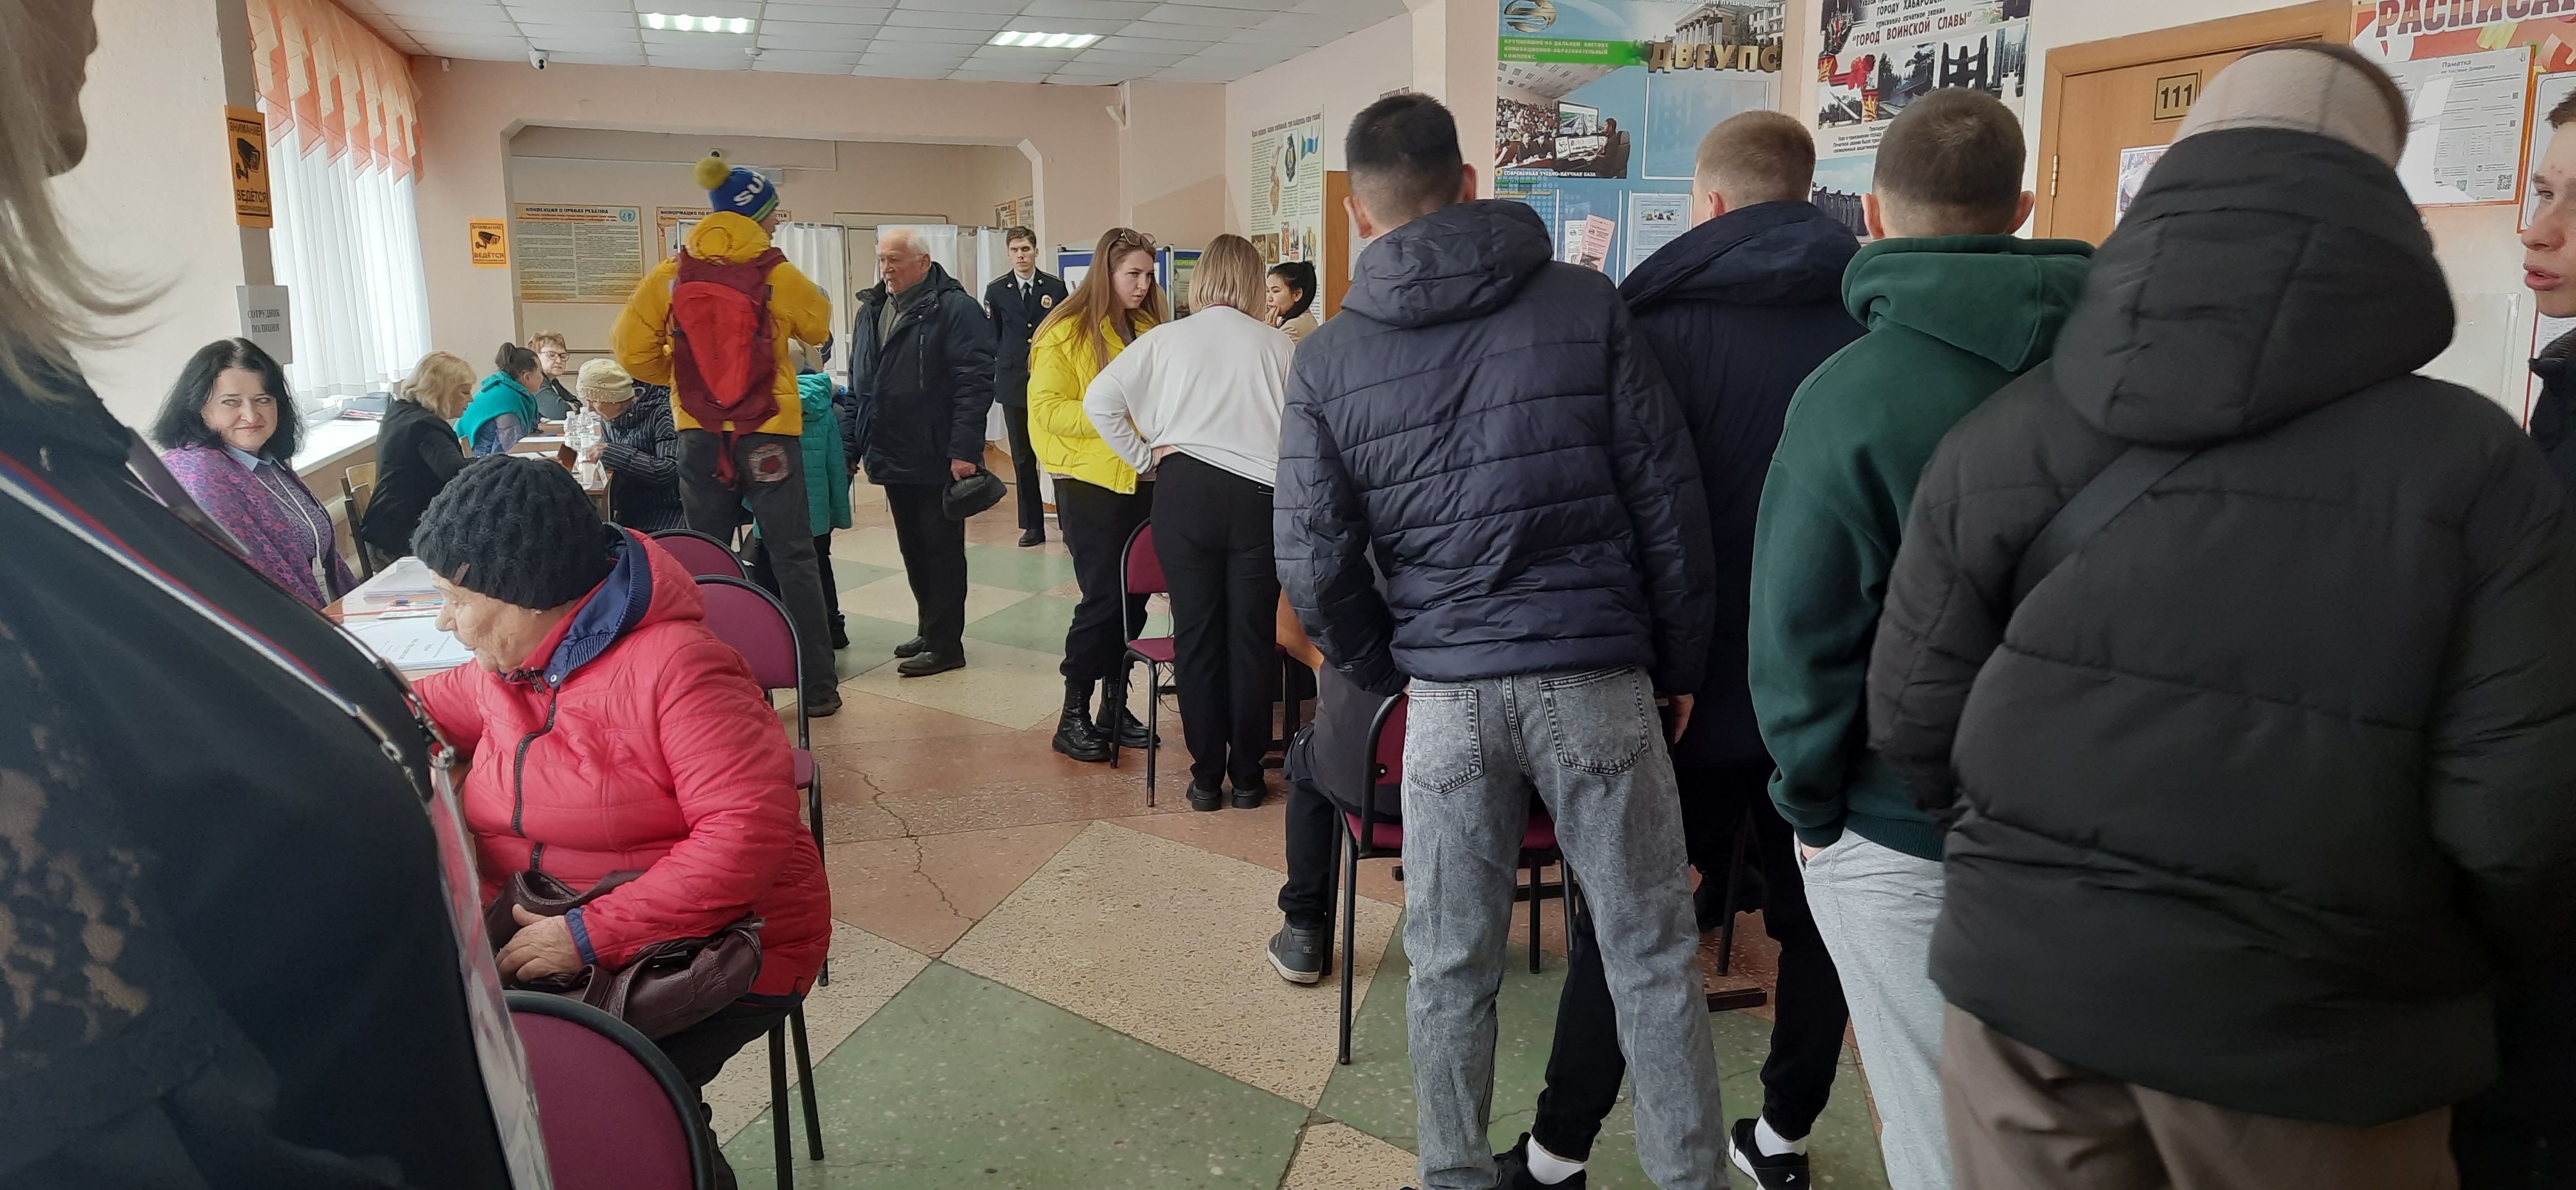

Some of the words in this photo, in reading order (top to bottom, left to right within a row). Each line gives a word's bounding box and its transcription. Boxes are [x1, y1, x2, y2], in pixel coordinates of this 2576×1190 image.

[1877, 2, 1899, 16] ГОРОДУ
[1902, 0, 1945, 10] ХАБАРОВ
[1887, 17, 1930, 40] ВОИНСКОЙ
[2375, 0, 2576, 38] РАСПИС
[1648, 41, 1778, 74] ДВГУПС
[2161, 84, 2193, 109] 111
[230, 122, 261, 136] ВНИМАНИЕ
[237, 188, 267, 203] ВЕДЁТСЯ
[733, 170, 765, 207] SU
[247, 309, 280, 318] СОТРУДНИК
[251, 324, 279, 333] ПОЛИЦИИ
